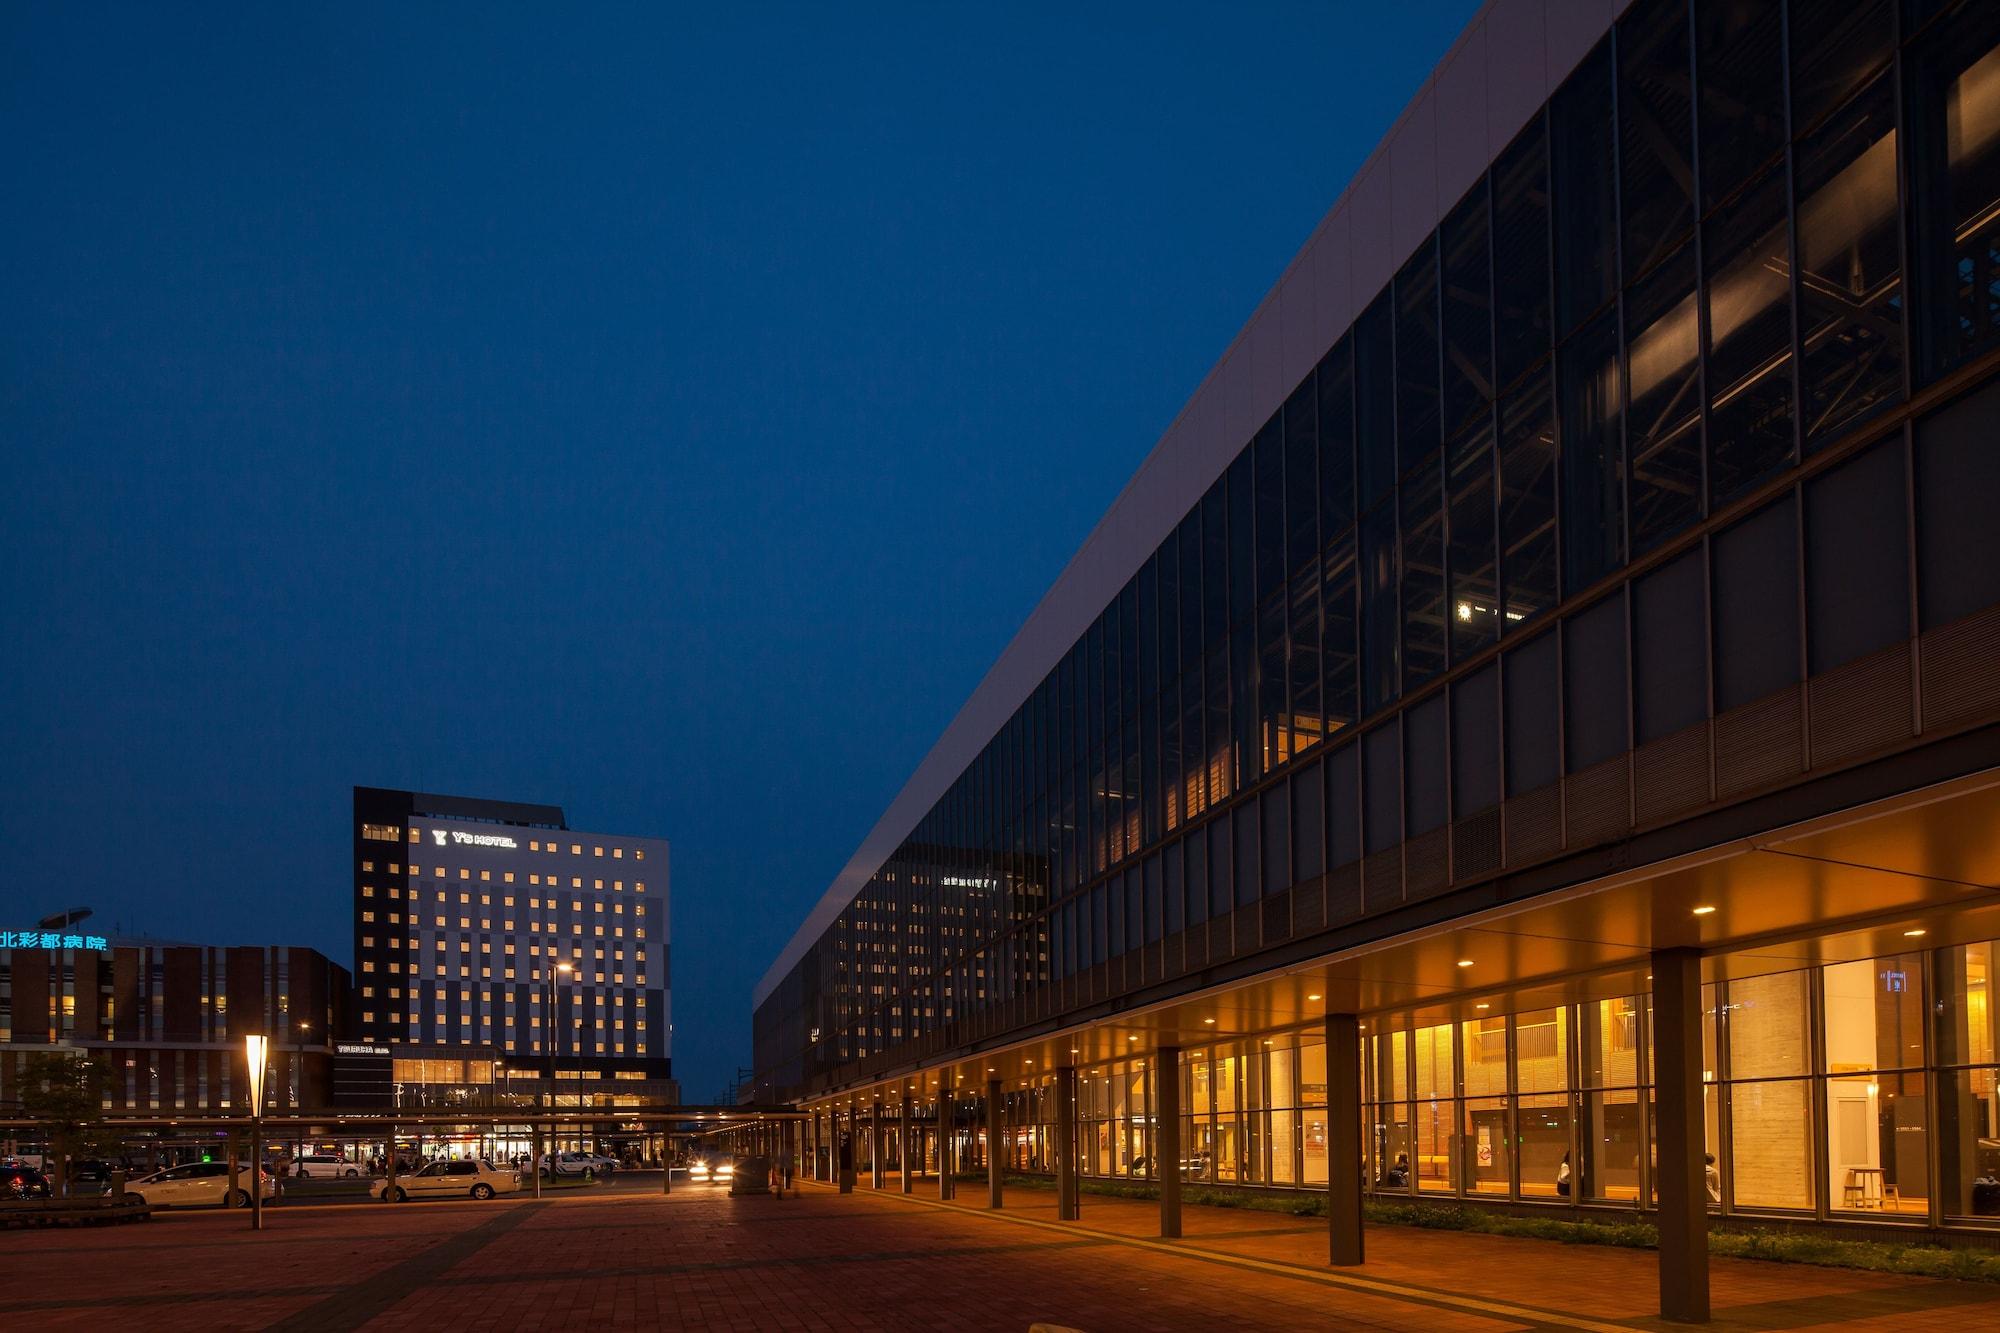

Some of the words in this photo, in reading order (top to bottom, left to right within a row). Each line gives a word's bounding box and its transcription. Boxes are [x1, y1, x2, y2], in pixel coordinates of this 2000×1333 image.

[474, 835, 517, 848] HOTEL
[0, 931, 107, 951] 北彩都病院
